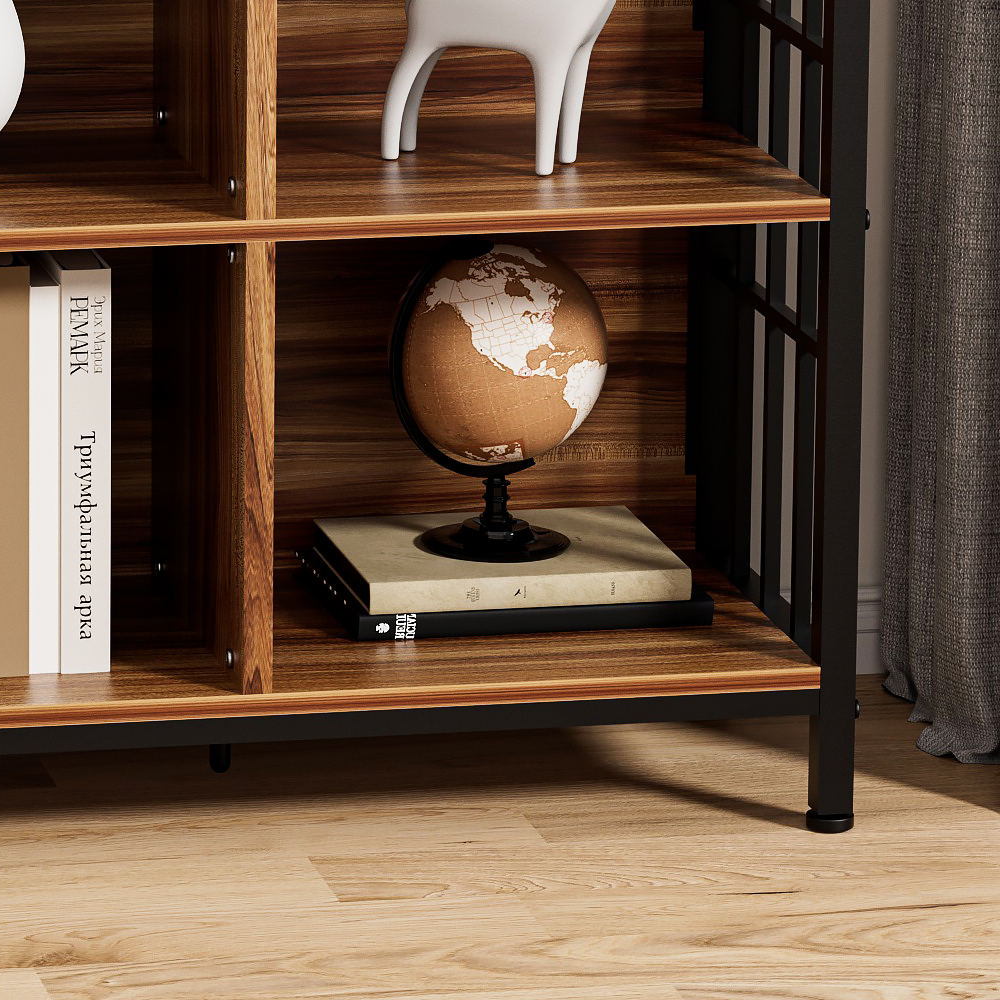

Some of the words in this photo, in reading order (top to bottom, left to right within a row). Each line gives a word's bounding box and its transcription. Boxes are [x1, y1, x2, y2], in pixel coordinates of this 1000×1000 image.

[91, 296, 107, 328] Эрих
[70, 296, 88, 375] РЕМАРК
[92, 331, 107, 374] Мария
[74, 431, 97, 585] Триумфальная
[74, 595, 91, 639] арка
